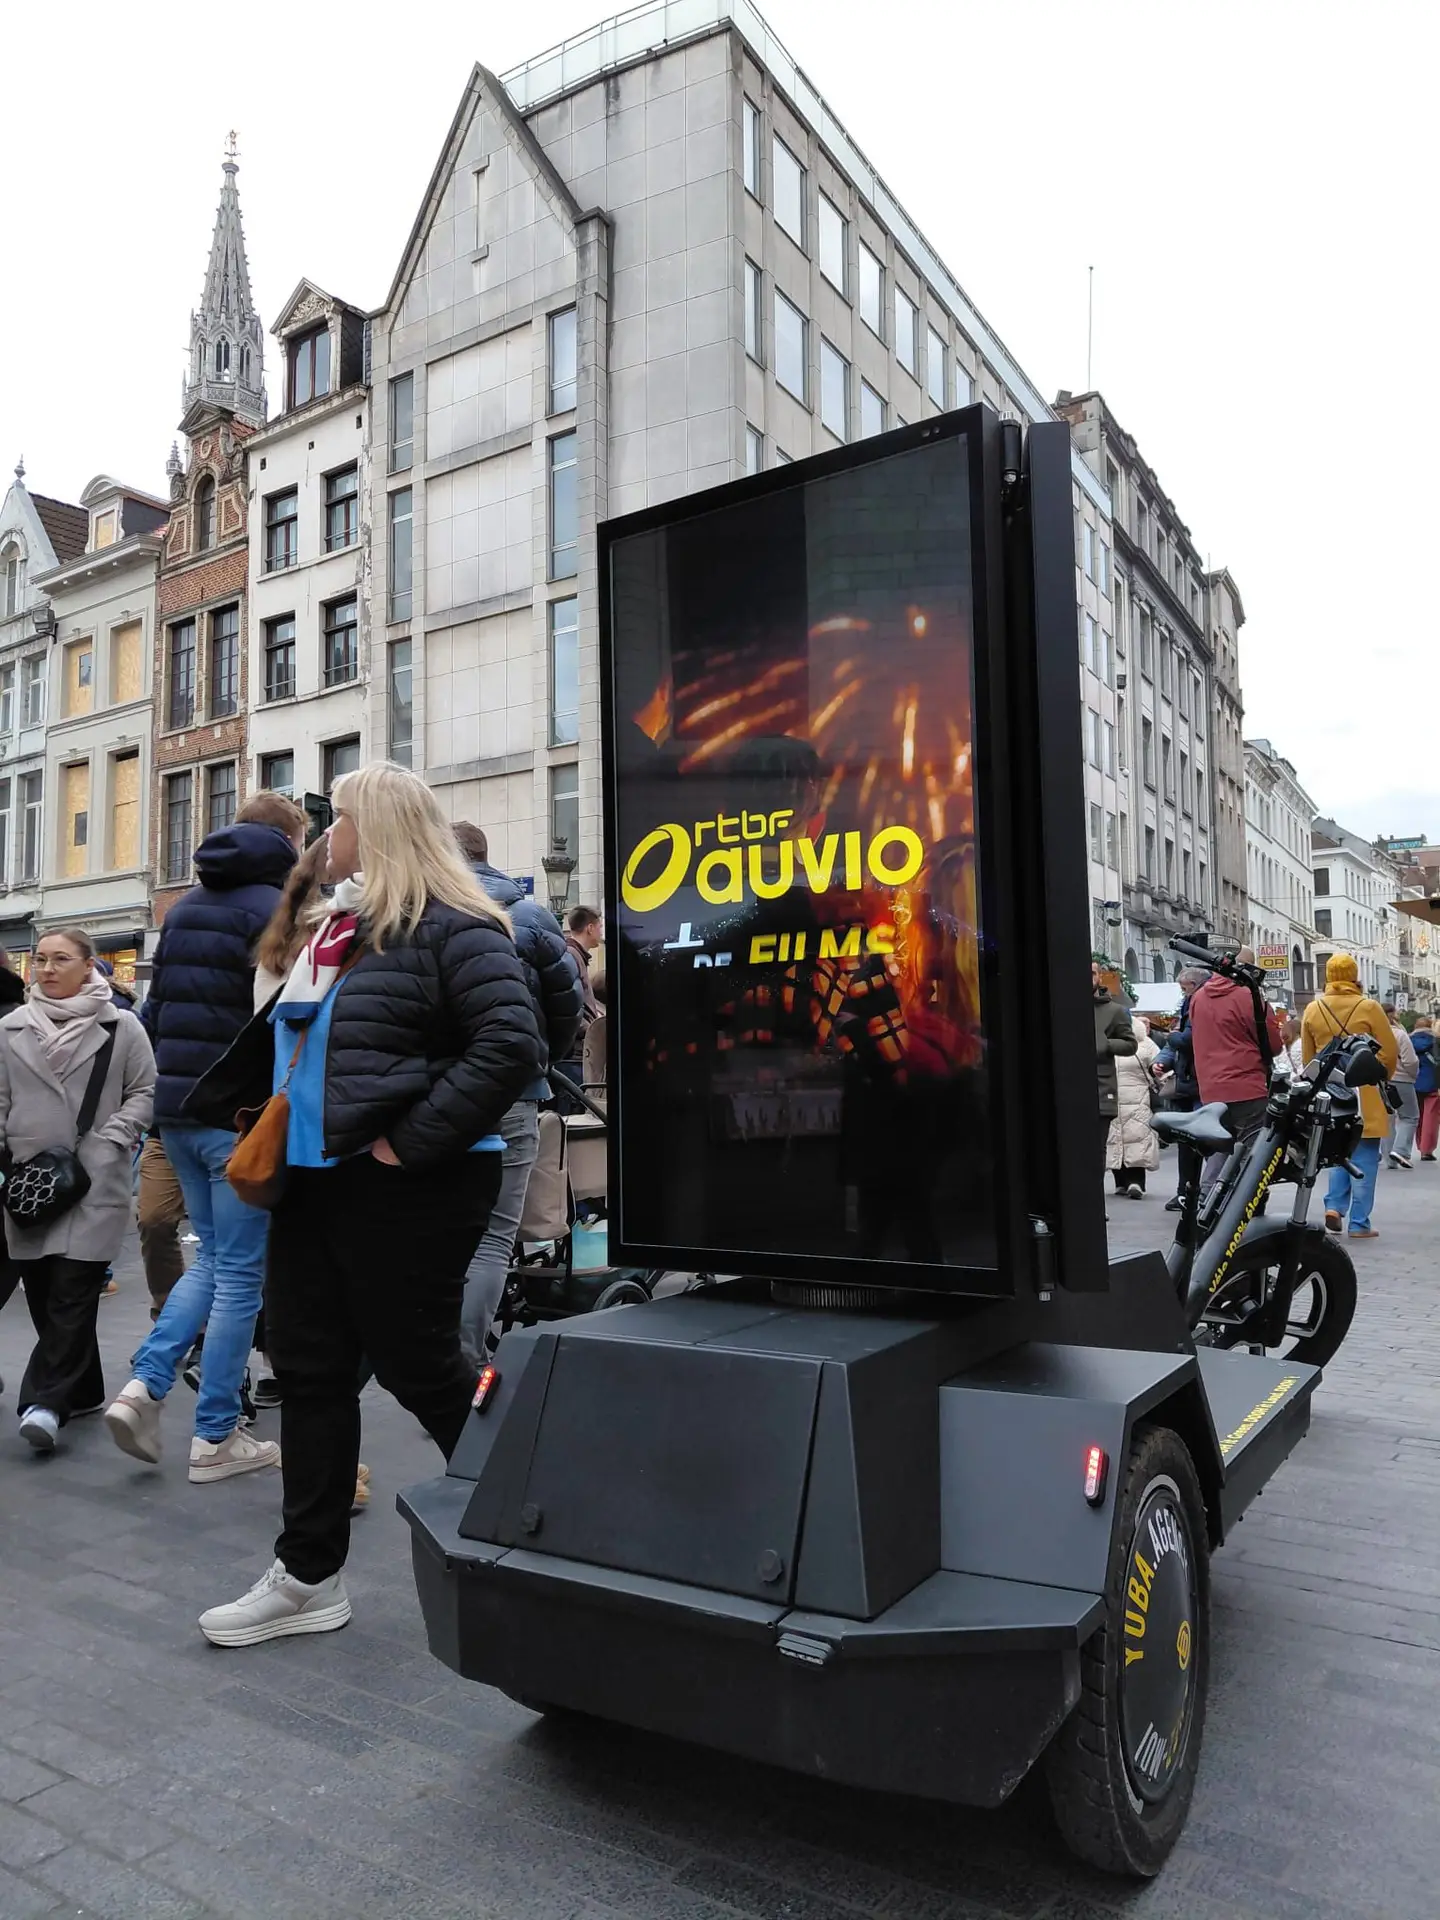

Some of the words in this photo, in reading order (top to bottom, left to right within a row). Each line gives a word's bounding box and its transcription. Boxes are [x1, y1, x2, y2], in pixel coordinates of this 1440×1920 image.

[694, 809, 794, 847] rtbf
[1260, 945, 1286, 955] ACHAT
[1263, 958, 1285, 967] OR
[1266, 970, 1287, 979] RGENT
[1225, 1220, 1248, 1258] 100%
